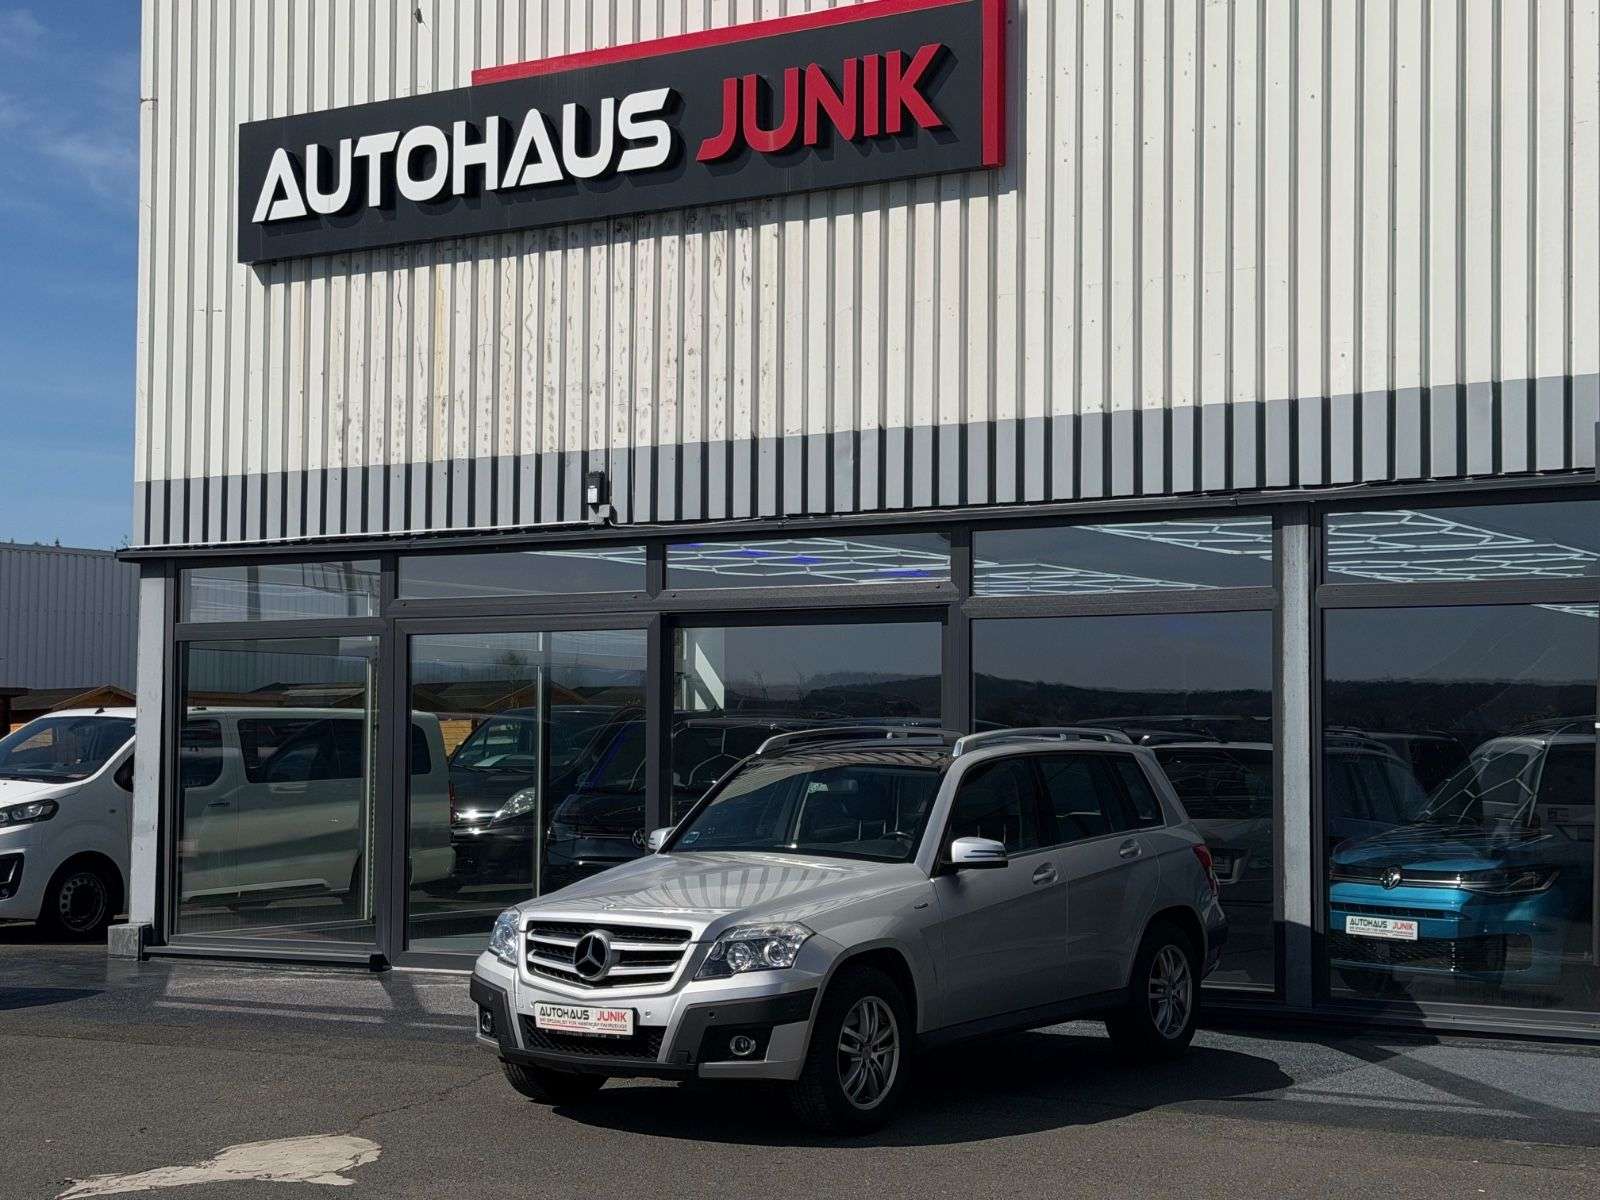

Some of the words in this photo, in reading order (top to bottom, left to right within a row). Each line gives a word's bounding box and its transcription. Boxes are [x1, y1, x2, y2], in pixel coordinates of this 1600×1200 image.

[252, 87, 671, 222] AUTOHAUS
[696, 43, 943, 162] JUNIK
[1349, 918, 1387, 929] AUTOHAUS
[540, 1006, 590, 1020] AUTOHAUS
[597, 1010, 627, 1022] JUNIK
